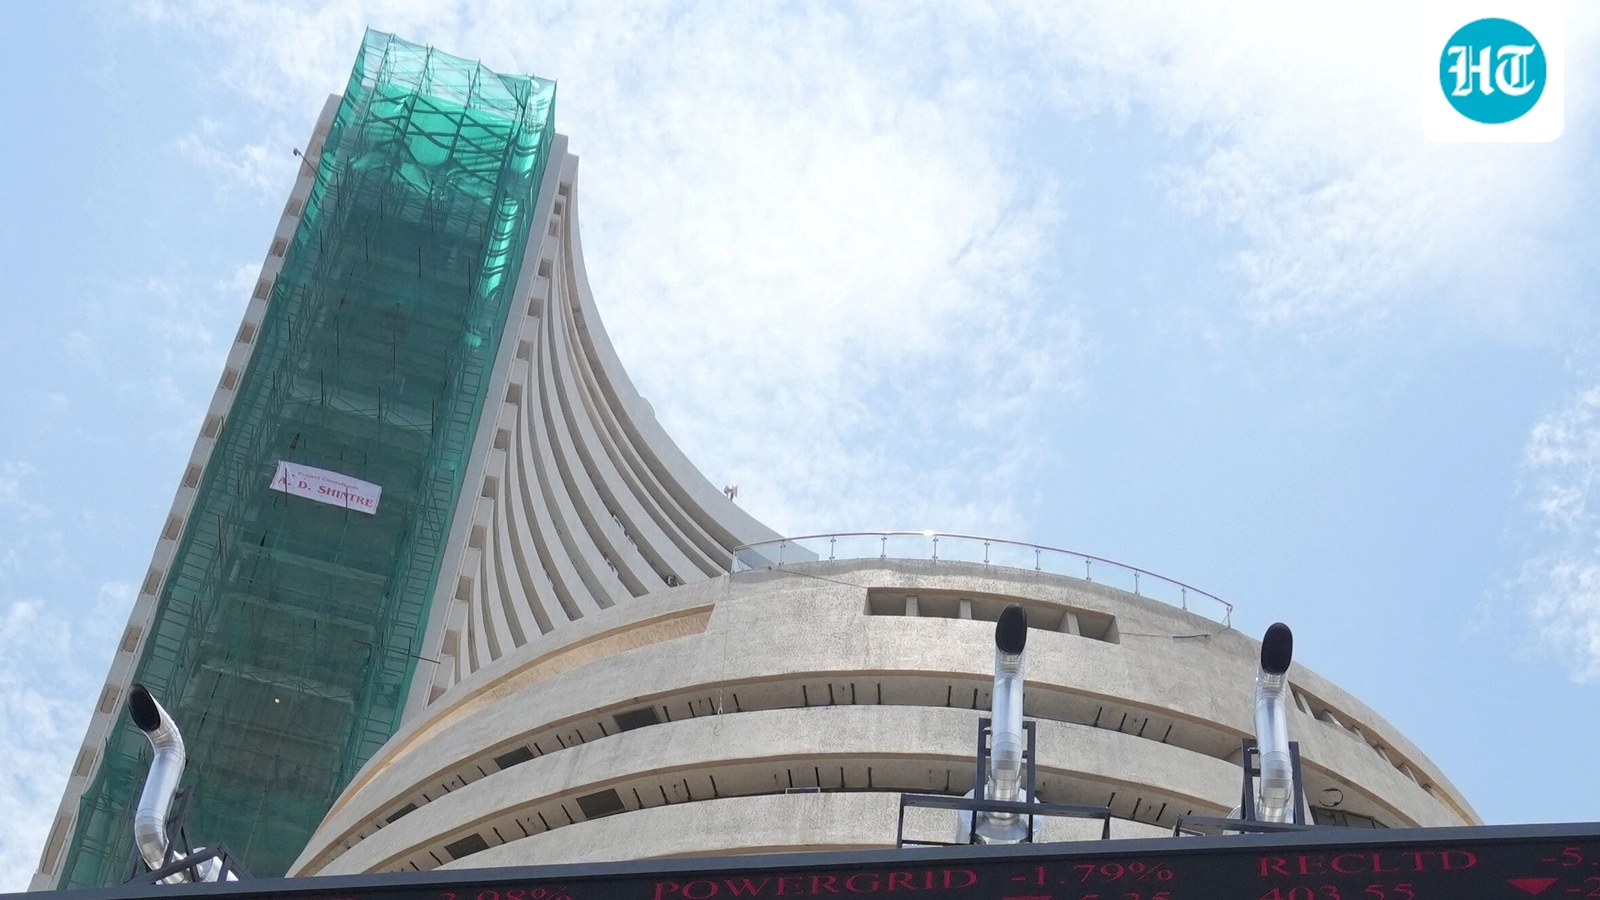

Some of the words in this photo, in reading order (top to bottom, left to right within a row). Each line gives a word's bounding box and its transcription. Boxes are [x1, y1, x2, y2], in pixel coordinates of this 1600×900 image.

[278, 476, 292, 486] A.
[298, 480, 311, 491] D.
[317, 485, 374, 508] SHINTRE
[1259, 850, 1478, 877] RECLTD
[653, 869, 978, 900] POWERGRID
[1011, 860, 1174, 885] -1.79%
[1259, 883, 1416, 900] 40355
